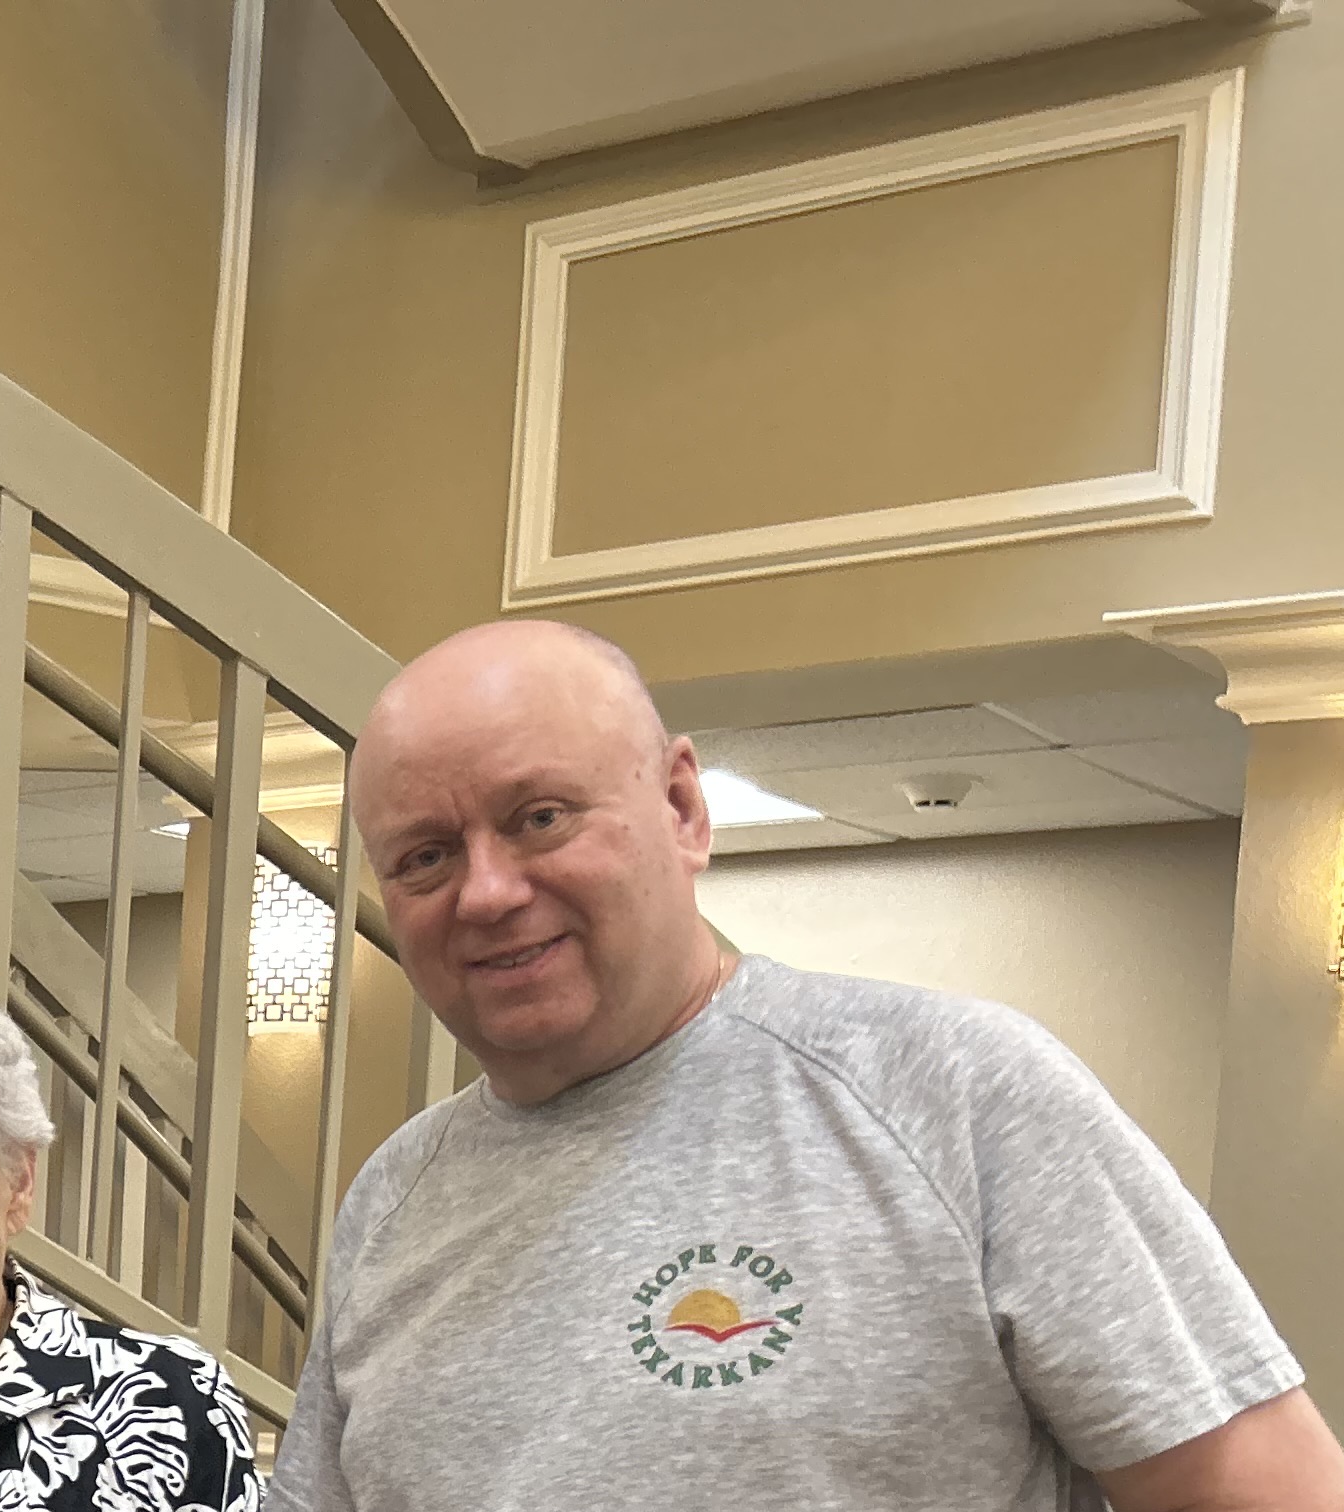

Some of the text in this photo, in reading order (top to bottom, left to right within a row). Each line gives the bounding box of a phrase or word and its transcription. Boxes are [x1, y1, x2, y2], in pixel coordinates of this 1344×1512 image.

[632, 1244, 793, 1306] HOPE FOR
[627, 1303, 804, 1389] TEXARKANA
